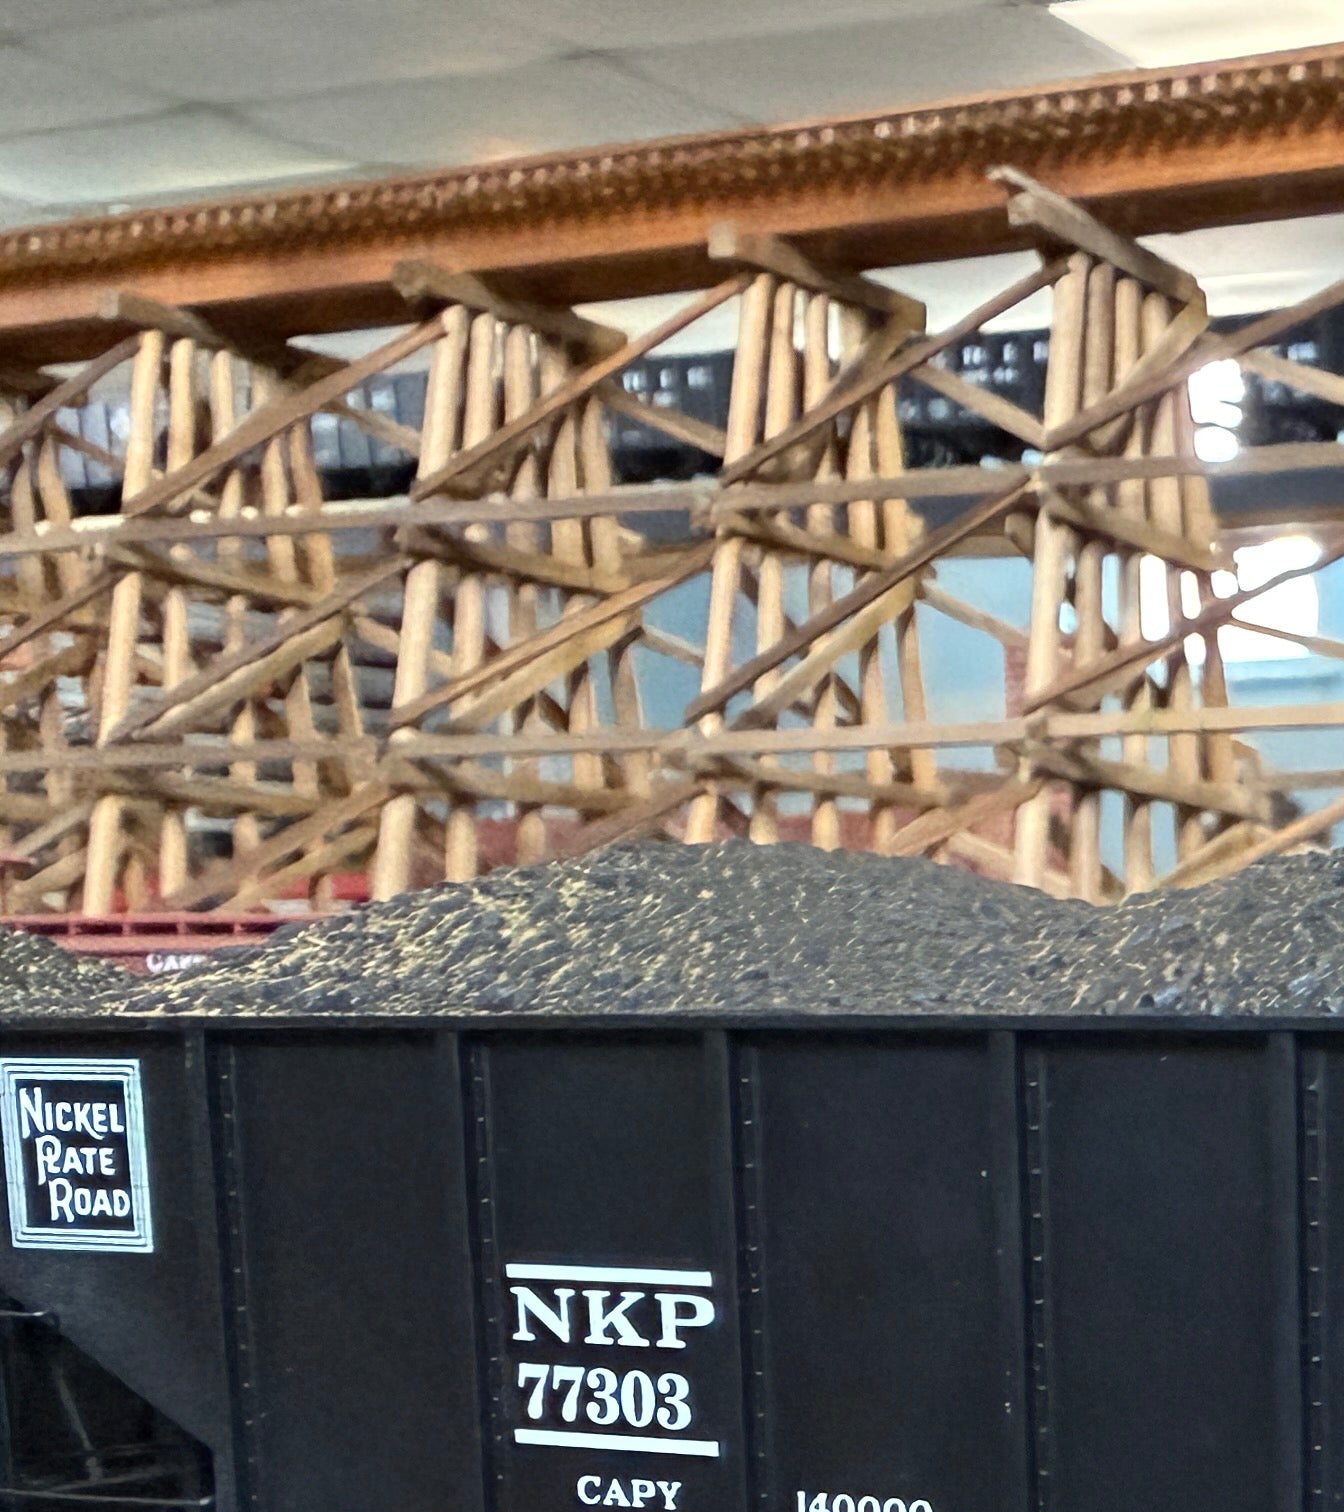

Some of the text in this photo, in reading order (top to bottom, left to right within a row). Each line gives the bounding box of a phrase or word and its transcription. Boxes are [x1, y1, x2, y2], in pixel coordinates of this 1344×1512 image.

[18, 1086, 125, 1140] NICKEL
[35, 1134, 117, 1186] PLATE
[48, 1177, 131, 1223] ROAD
[509, 1286, 716, 1349] NKP
[517, 1363, 693, 1432] 77303
[576, 1475, 682, 1511] CAPY
